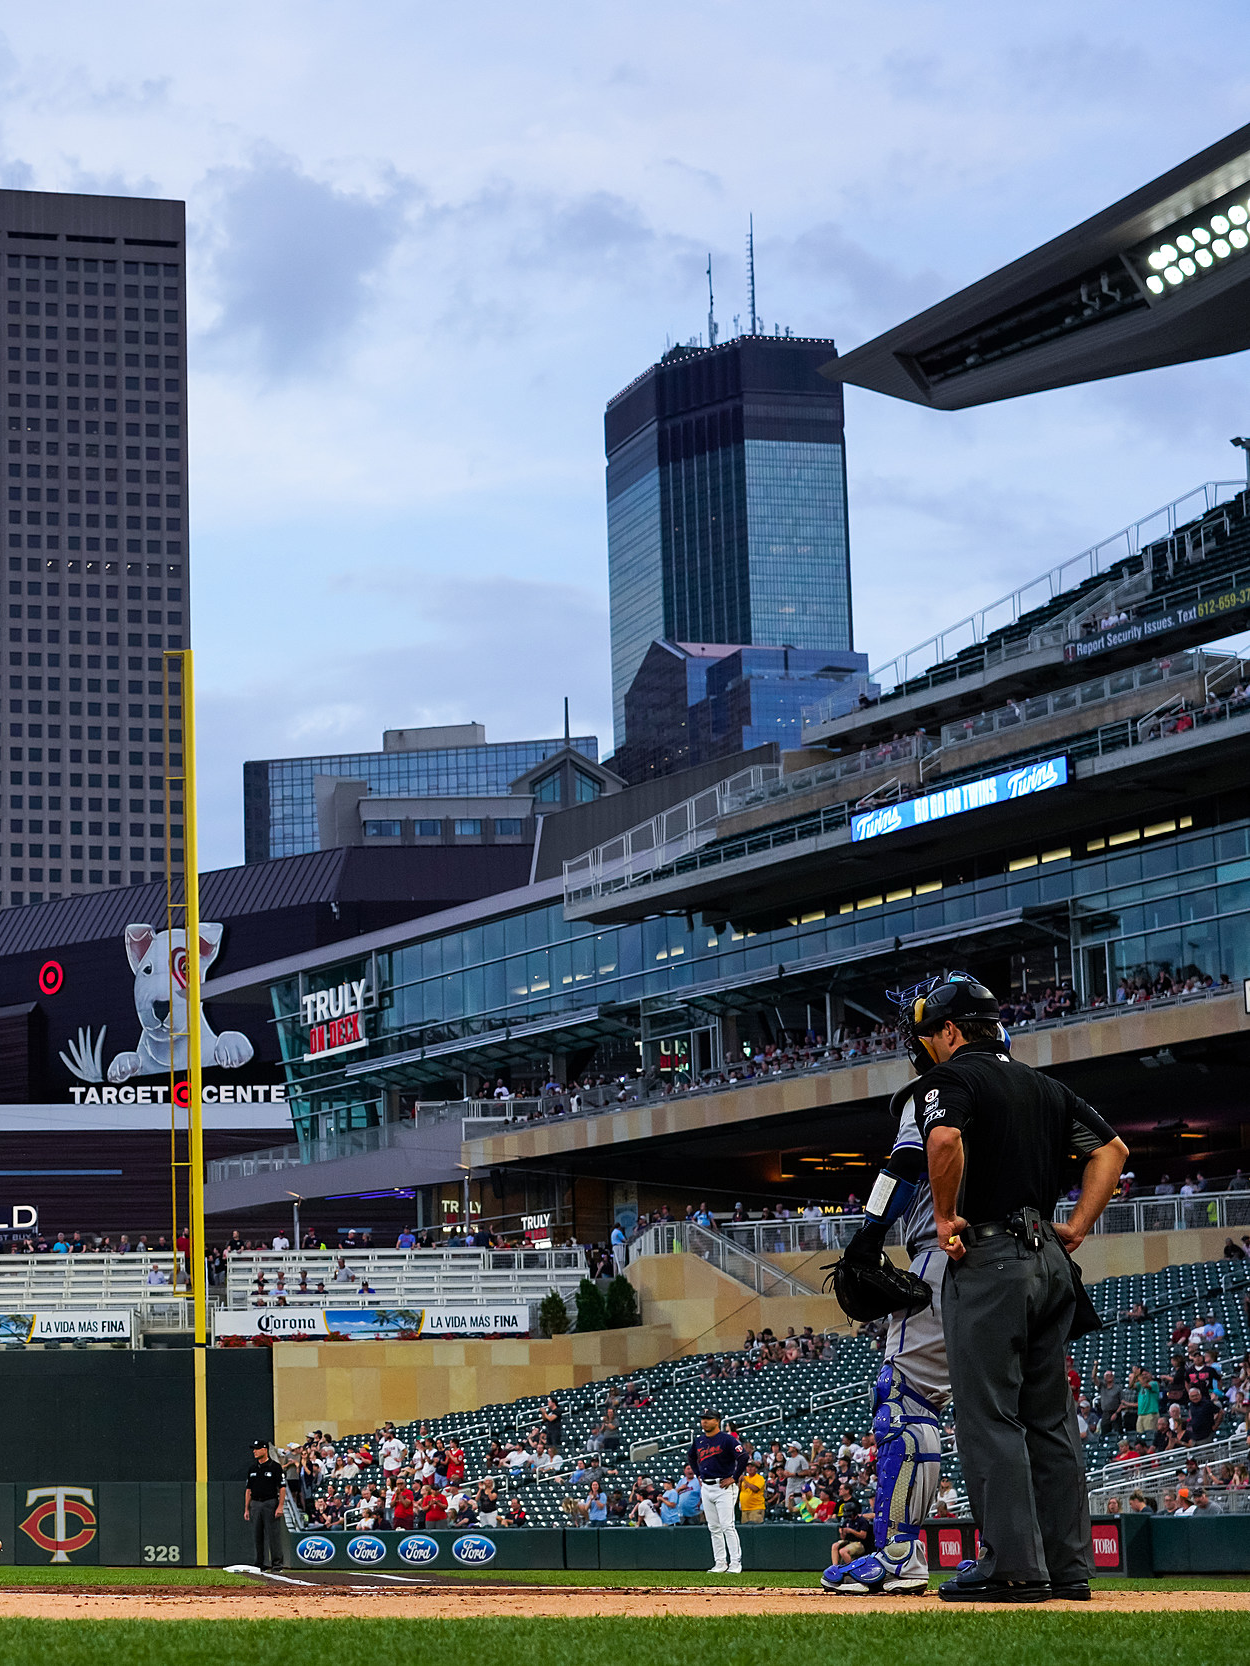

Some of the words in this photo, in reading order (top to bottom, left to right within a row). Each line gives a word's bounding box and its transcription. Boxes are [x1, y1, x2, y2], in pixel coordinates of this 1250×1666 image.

[1076, 635, 1105, 656] Report
[1106, 624, 1142, 648] Security
[1176, 608, 1197, 624] Text
[856, 806, 902, 841] Twins
[913, 797, 929, 824] GO
[930, 793, 945, 819] GO
[946, 788, 961, 815] GO
[961, 777, 997, 810] TWINS
[1007, 761, 1059, 799] Twins
[302, 978, 366, 1025] TRULY
[310, 1025, 327, 1055] ON
[329, 1012, 361, 1049] DECK
[69, 1086, 169, 1105] TARGET
[202, 1085, 302, 1104] CENTE
[441, 1200, 482, 1214] TRLY
[521, 1213, 550, 1230] TRULY
[40, 1321, 52, 1333] LA
[54, 1320, 75, 1333] VIDA
[78, 1319, 98, 1333] MÁS
[101, 1320, 125, 1332] FINA
[258, 1314, 316, 1334] Corona
[430, 1316, 443, 1328] LA
[446, 1316, 467, 1328] VIDA
[470, 1314, 490, 1328] MÁS
[494, 1315, 518, 1327] FINA
[144, 1545, 181, 1562] 328
[303, 1540, 328, 1560] Ford
[354, 1539, 378, 1560] Ford
[405, 1539, 430, 1560] Ford
[460, 1538, 487, 1560] Ford
[940, 1541, 960, 1556] TORO
[1093, 1539, 1118, 1555] TORO
